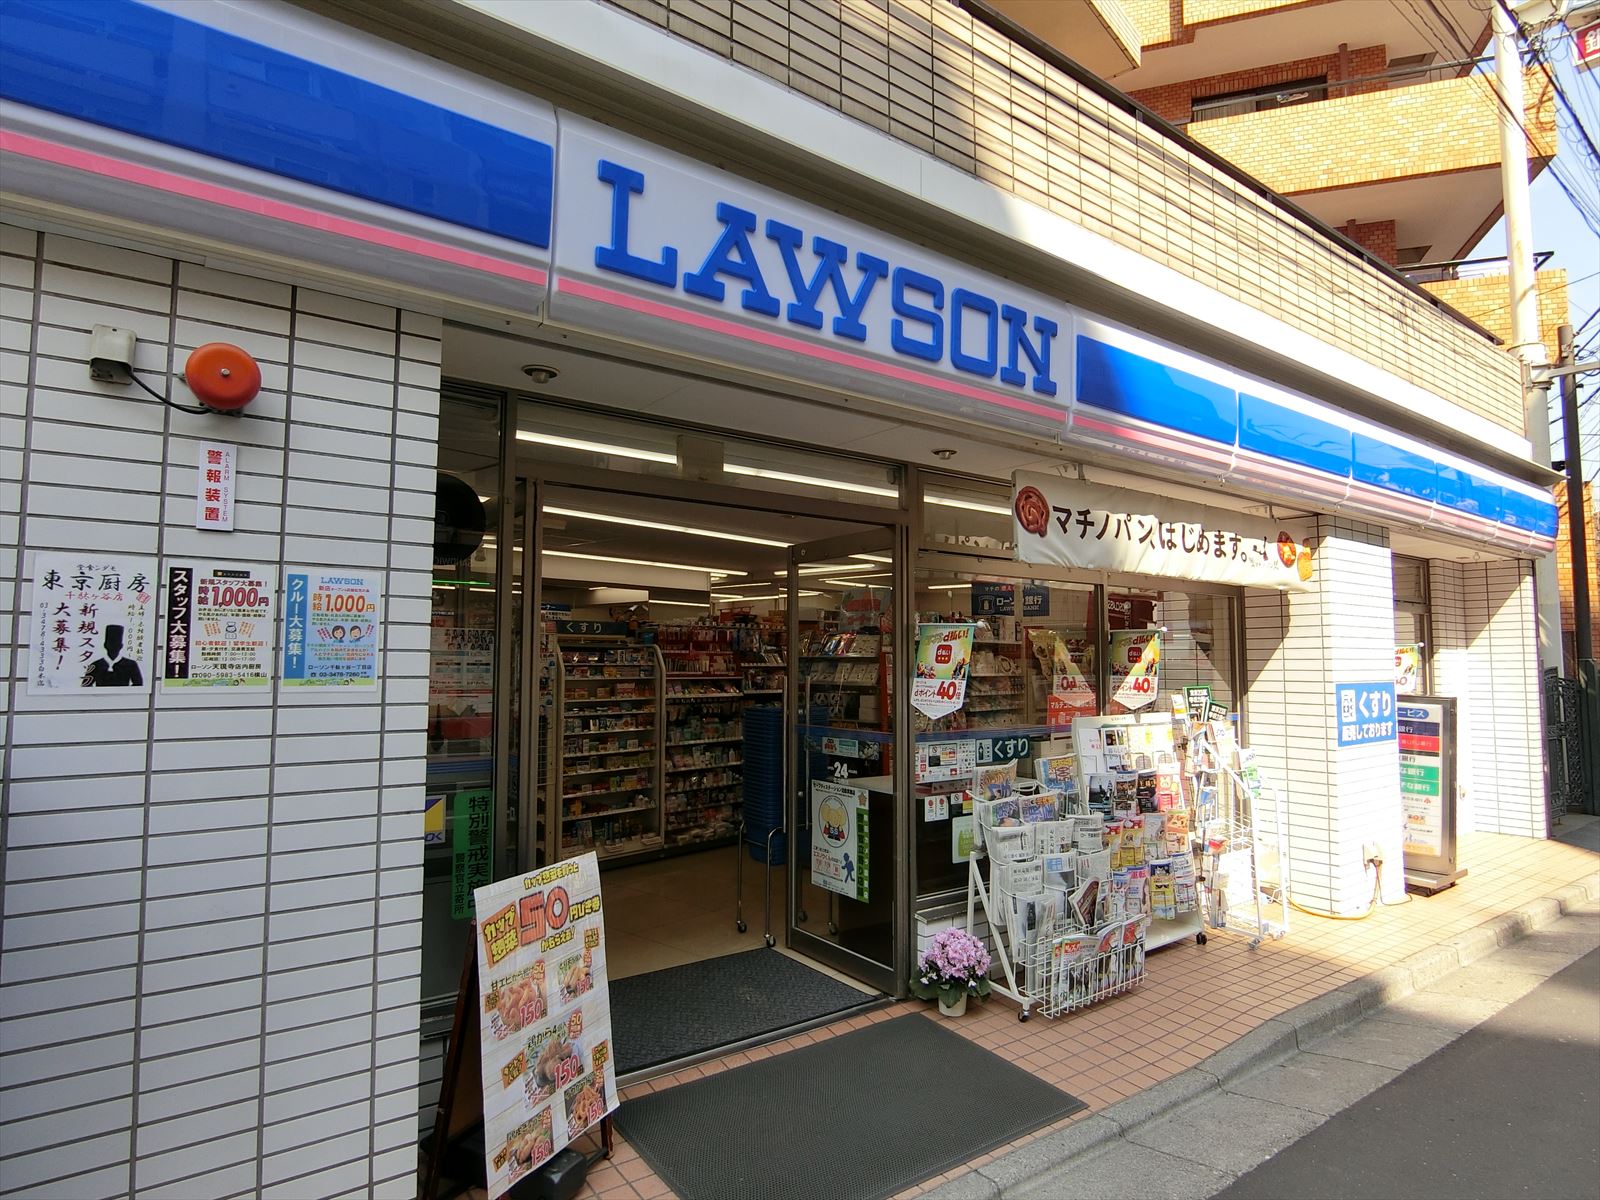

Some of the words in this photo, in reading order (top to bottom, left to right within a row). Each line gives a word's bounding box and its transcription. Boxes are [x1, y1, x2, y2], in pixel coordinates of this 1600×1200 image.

[595, 160, 1058, 397] LAWSON
[204, 449, 223, 521] 警報装置
[222, 486, 230, 522] SYSTEM
[1052, 504, 1248, 562] マチノパン、はじめます。
[42, 569, 150, 593] 東京厨房
[320, 576, 364, 586] LAWSON
[996, 595, 1042, 606] ローソ銀行
[168, 570, 189, 678] スタッフ大募集!
[287, 578, 304, 669] クルー大募集!
[566, 622, 602, 634] くすり
[78, 603, 100, 688] 新規スタッフ
[936, 680, 957, 701] 40
[1132, 677, 1151, 694] 40
[1359, 690, 1392, 719] くすり
[1397, 709, 1426, 719] ービス
[993, 737, 1029, 759] くすり
[518, 885, 570, 947] 50
